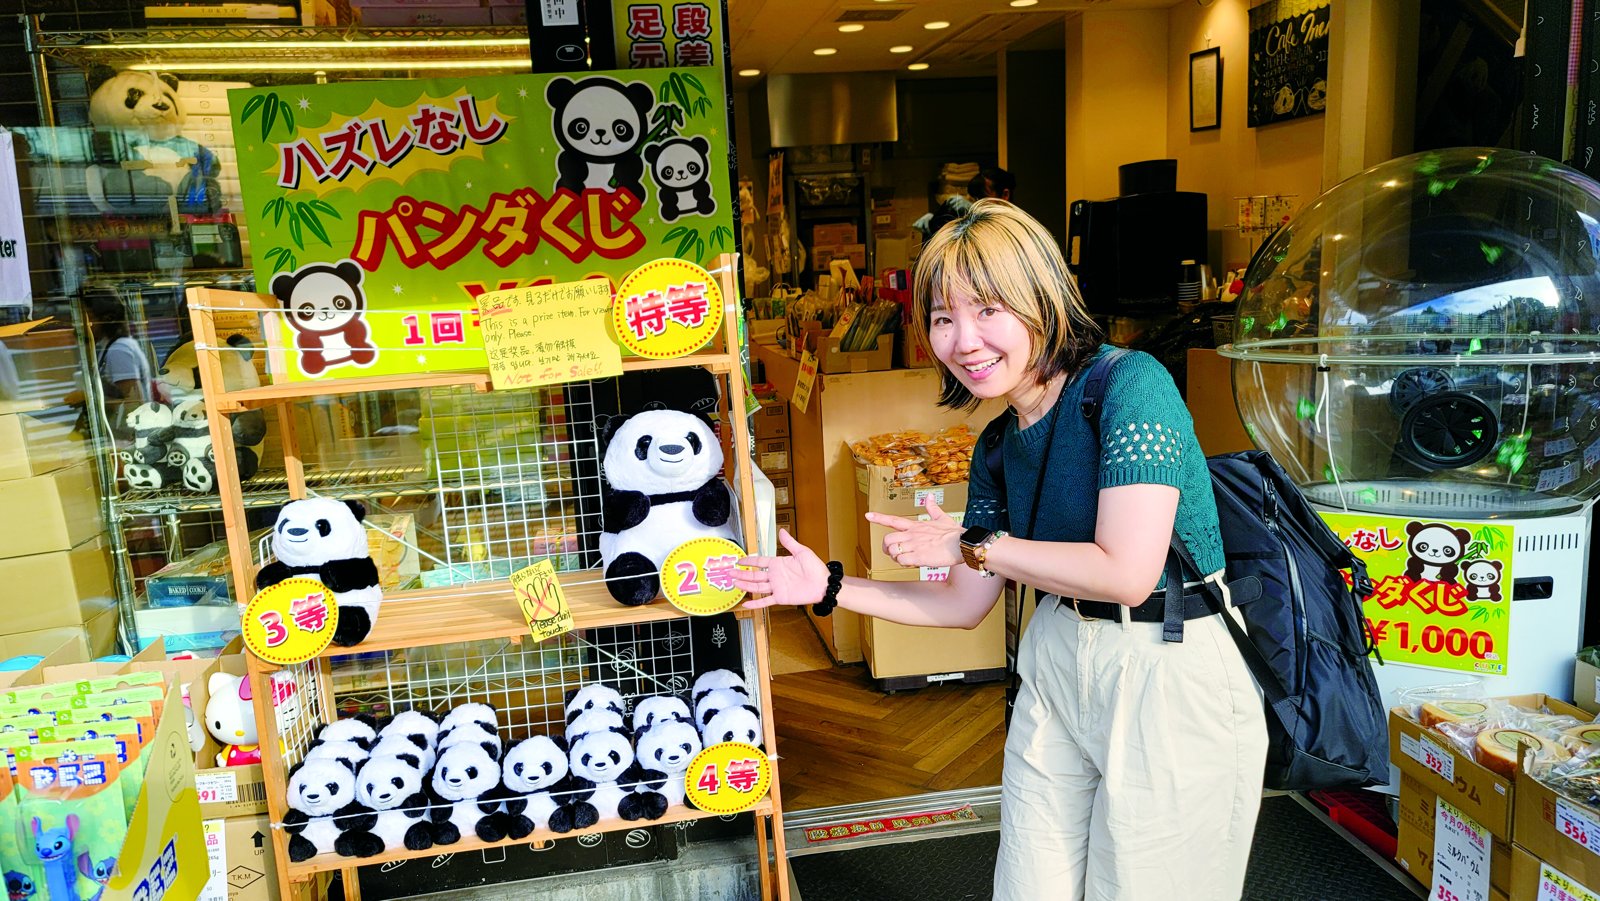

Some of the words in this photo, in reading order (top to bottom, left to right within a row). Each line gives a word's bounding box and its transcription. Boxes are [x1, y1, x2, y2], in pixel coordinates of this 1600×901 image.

[631, 8, 664, 67] 足元
[677, 7, 709, 66] 段差
[1266, 22, 1298, 56] Cafe
[279, 94, 507, 190] ハズレなし
[351, 187, 646, 271] パンダくじ
[404, 311, 466, 346] 1回
[481, 318, 503, 331] This
[509, 316, 518, 326] is
[522, 318, 529, 326] a
[532, 311, 554, 327] prize
[578, 306, 590, 318] For
[625, 282, 710, 340] 特等
[504, 372, 534, 385] Not
[539, 367, 562, 380] for
[672, 555, 741, 595] 2等
[258, 593, 328, 648] 3等
[530, 617, 557, 633] Please
[1365, 617, 1494, 660] ¥1,000
[29, 760, 107, 790] PEZ
[697, 761, 761, 795] 4等
[1425, 753, 1443, 773] 352
[1441, 811, 1485, 849] 今月の特売品
[1564, 821, 1588, 845] 556
[232, 873, 251, 881] T.K.M
